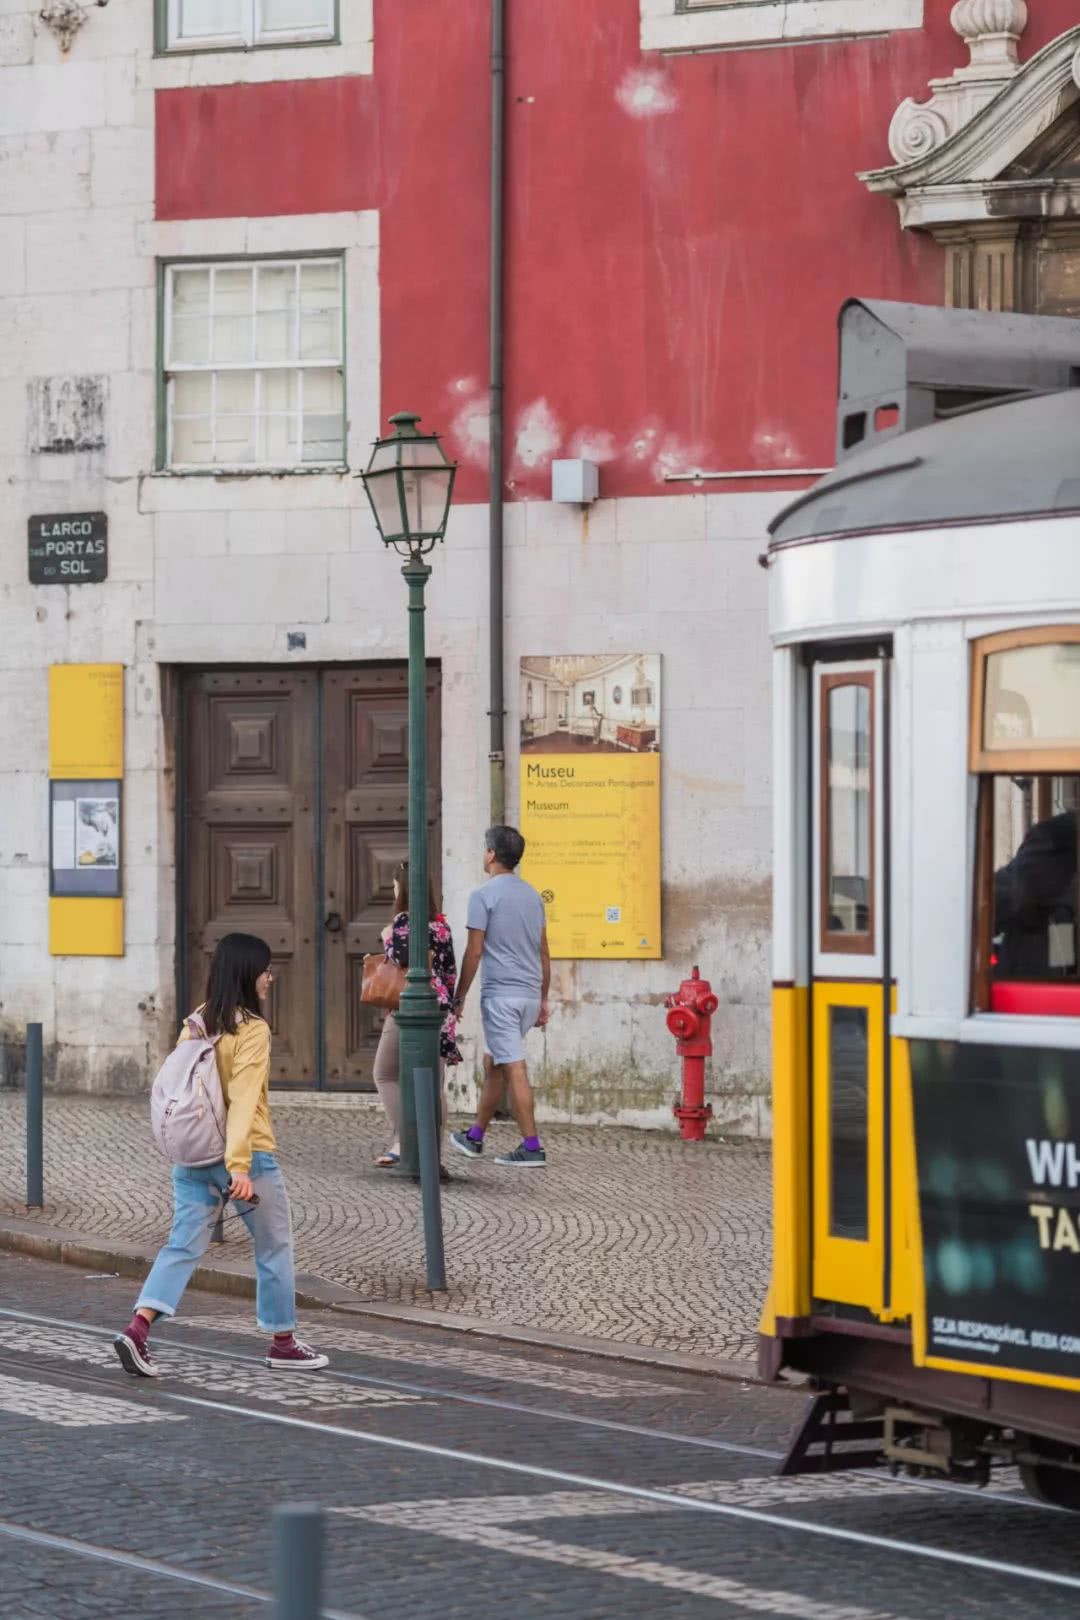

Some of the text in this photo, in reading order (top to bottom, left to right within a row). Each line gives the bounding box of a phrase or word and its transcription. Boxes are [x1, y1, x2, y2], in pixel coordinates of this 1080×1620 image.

[40, 521, 92, 537] LARGO
[45, 539, 105, 556] PORTAS
[60, 559, 91, 575] SOL
[527, 764, 574, 778] Museu
[527, 800, 569, 811] Museum
[1029, 1204, 1080, 1253] TA
[933, 1316, 956, 1335] SEJA
